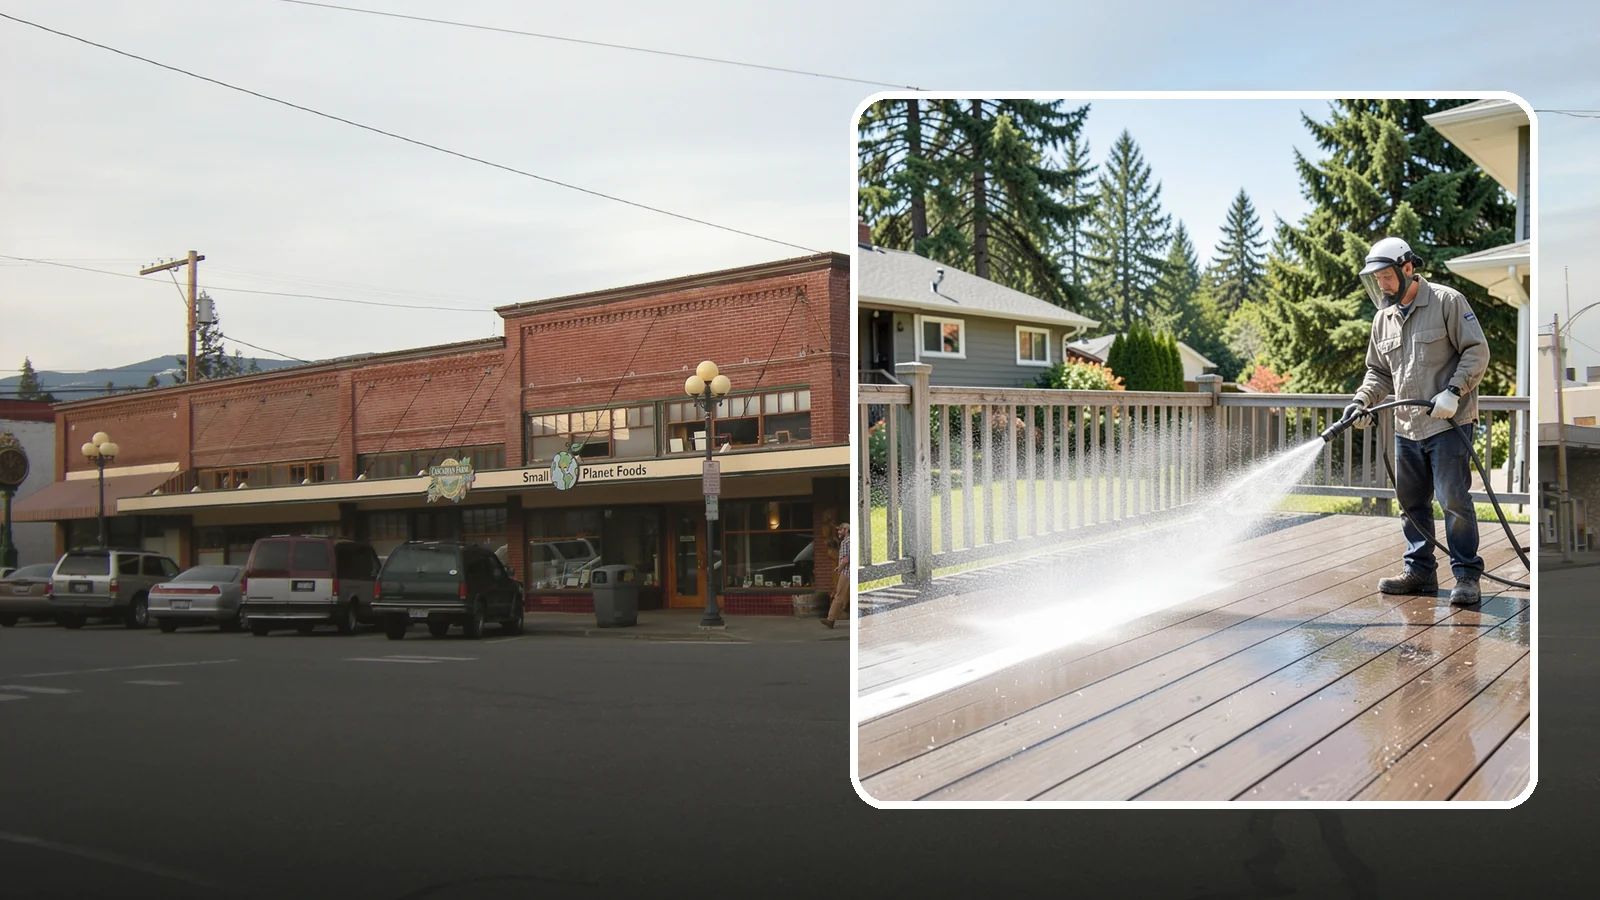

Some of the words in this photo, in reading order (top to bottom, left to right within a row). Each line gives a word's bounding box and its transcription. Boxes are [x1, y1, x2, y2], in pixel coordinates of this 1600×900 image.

[523, 471, 549, 483] Small
[583, 468, 614, 479] Planet
[617, 464, 647, 477] Foods
